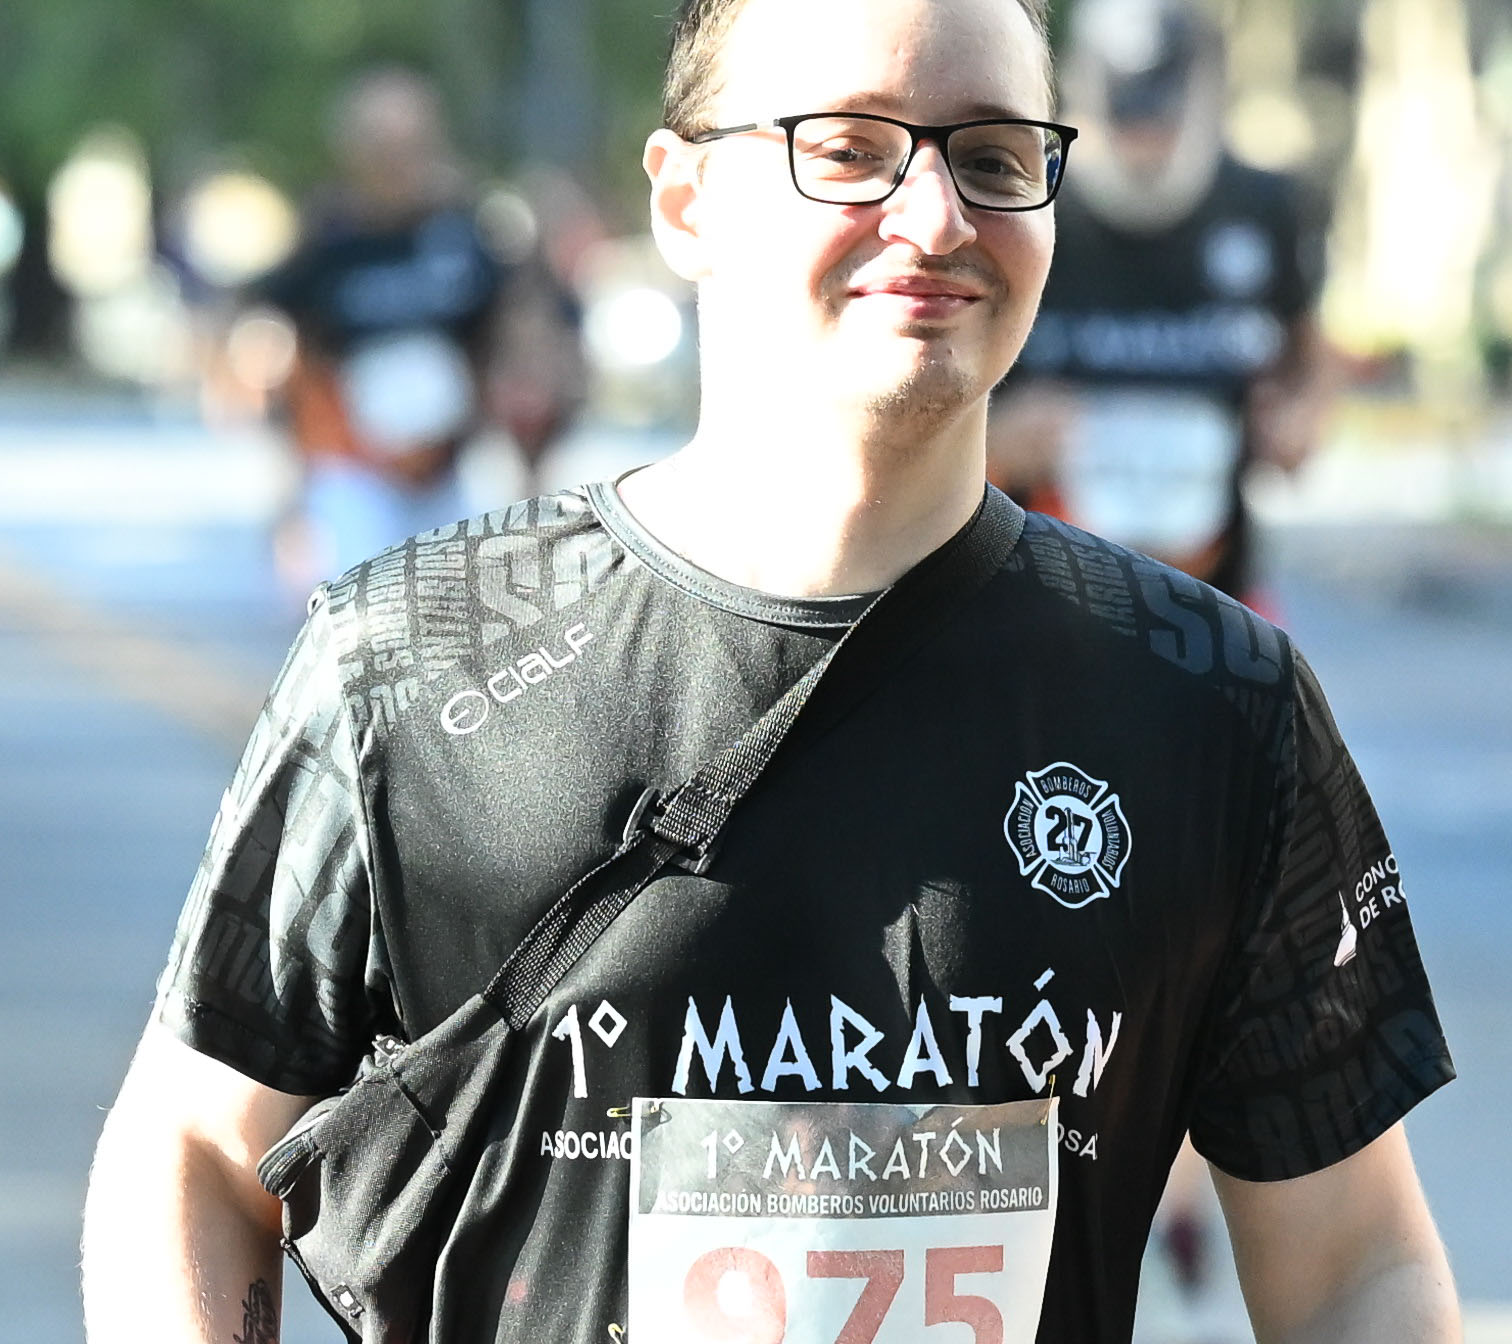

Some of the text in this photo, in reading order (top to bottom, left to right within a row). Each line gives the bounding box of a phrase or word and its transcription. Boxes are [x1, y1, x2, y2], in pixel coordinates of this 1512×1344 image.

[1040, 776, 1092, 798] BOMBEROS
[1045, 805, 1093, 852] 27
[1050, 873, 1090, 894] ROSARIO
[1359, 896, 1380, 929] DE
[552, 999, 628, 1099] 1°
[671, 968, 1122, 1097] MARATÓN
[700, 1118, 1004, 1183] 1° MARATÓN
[657, 1186, 1042, 1215] ASOCIACIÓN BOMBEROS VOLUNTARIOS ROSARIO
